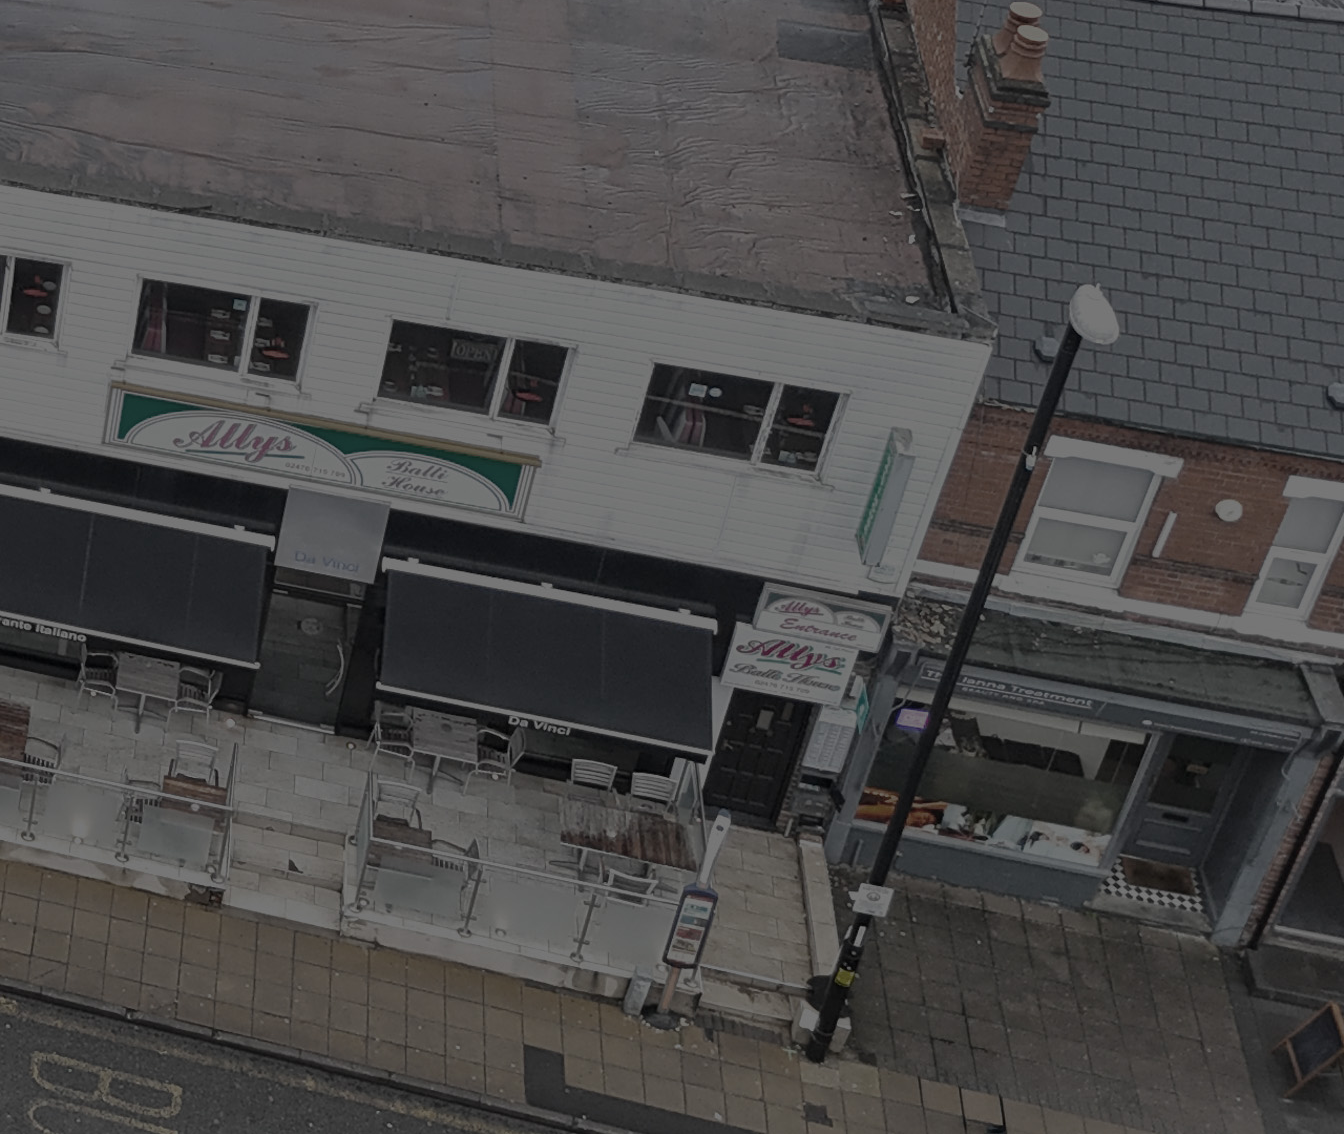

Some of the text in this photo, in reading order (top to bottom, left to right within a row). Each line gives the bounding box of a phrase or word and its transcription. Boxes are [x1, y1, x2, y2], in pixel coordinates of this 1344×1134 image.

[172, 420, 298, 463] Allys
[386, 459, 450, 480] Balti
[381, 475, 448, 497] House
[295, 550, 360, 573] Da Vinci
[780, 618, 858, 642] Entrance
[736, 639, 846, 670] Allys
[1011, 685, 1095, 706] Treatment
[508, 716, 571, 736] Da Vinci
